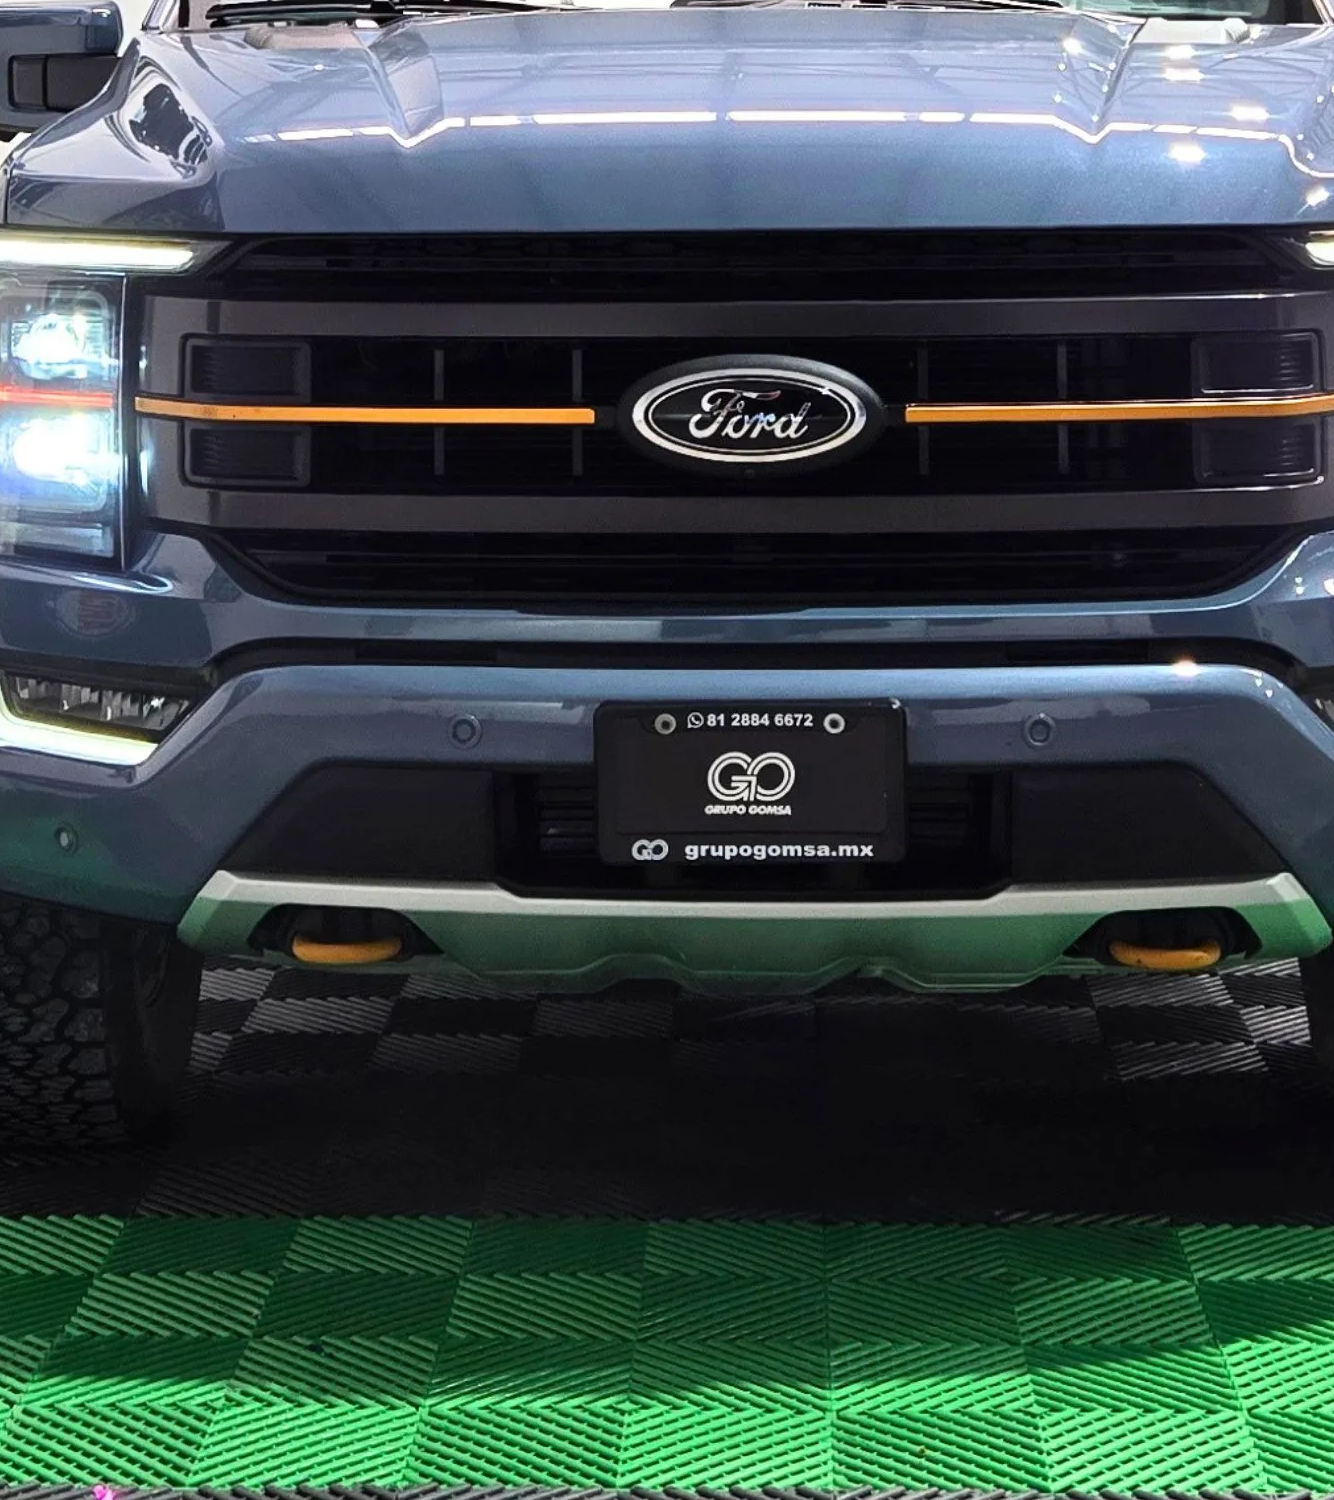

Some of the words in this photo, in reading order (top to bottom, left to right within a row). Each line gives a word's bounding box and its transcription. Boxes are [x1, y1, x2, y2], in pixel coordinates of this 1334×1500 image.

[688, 388, 812, 439] Ford
[707, 713, 725, 727] 81
[731, 713, 769, 727] 2884
[774, 713, 814, 727] 6672
[707, 751, 796, 801] GO
[704, 804, 746, 816] GRUPO
[748, 804, 792, 816] GOMSA
[684, 842, 874, 861] grupogomsa.mx
